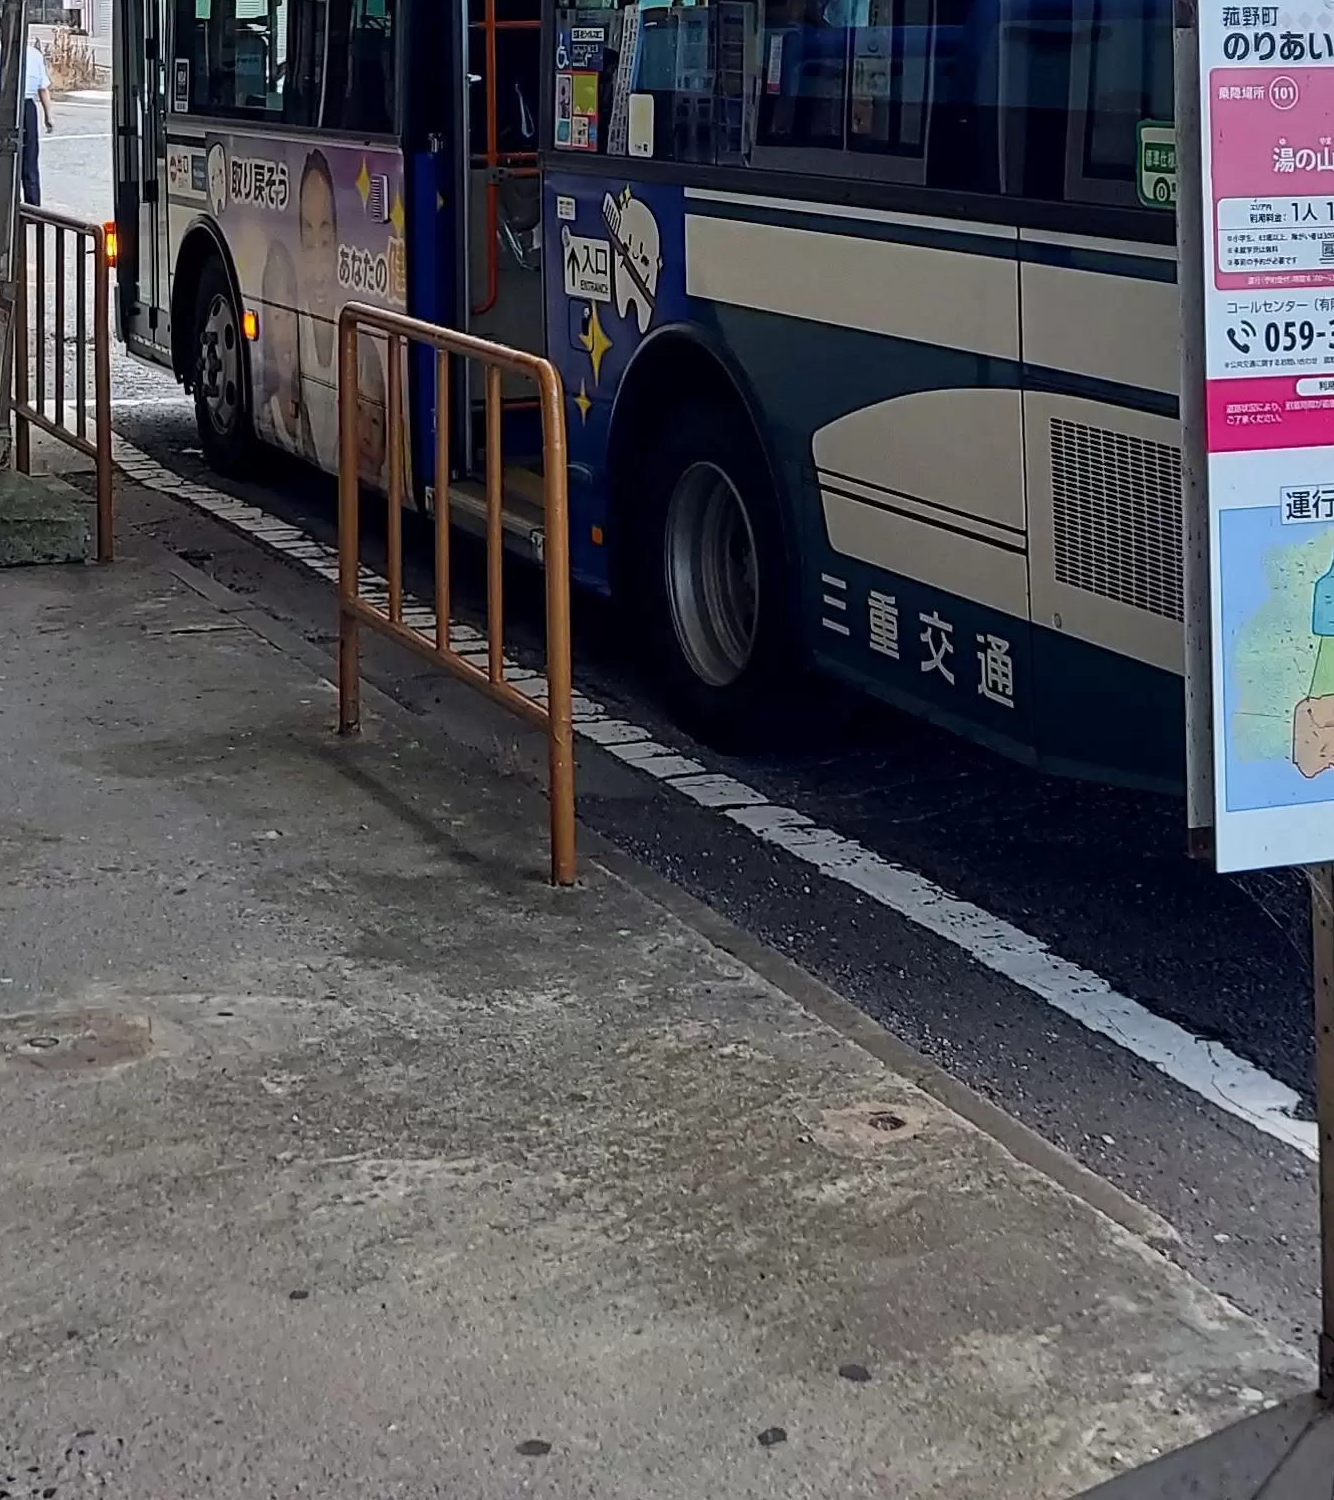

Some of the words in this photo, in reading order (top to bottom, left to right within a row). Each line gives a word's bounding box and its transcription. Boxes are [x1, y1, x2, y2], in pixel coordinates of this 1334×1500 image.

[1223, 6, 1279, 27] 菰野町
[1273, 86, 1294, 100] 101
[231, 160, 287, 206] 取り戻そう
[1291, 202, 1318, 221] 1人
[582, 245, 607, 276] 入口
[1227, 300, 1308, 314] コールセンター
[821, 572, 1015, 708] 三重交通
